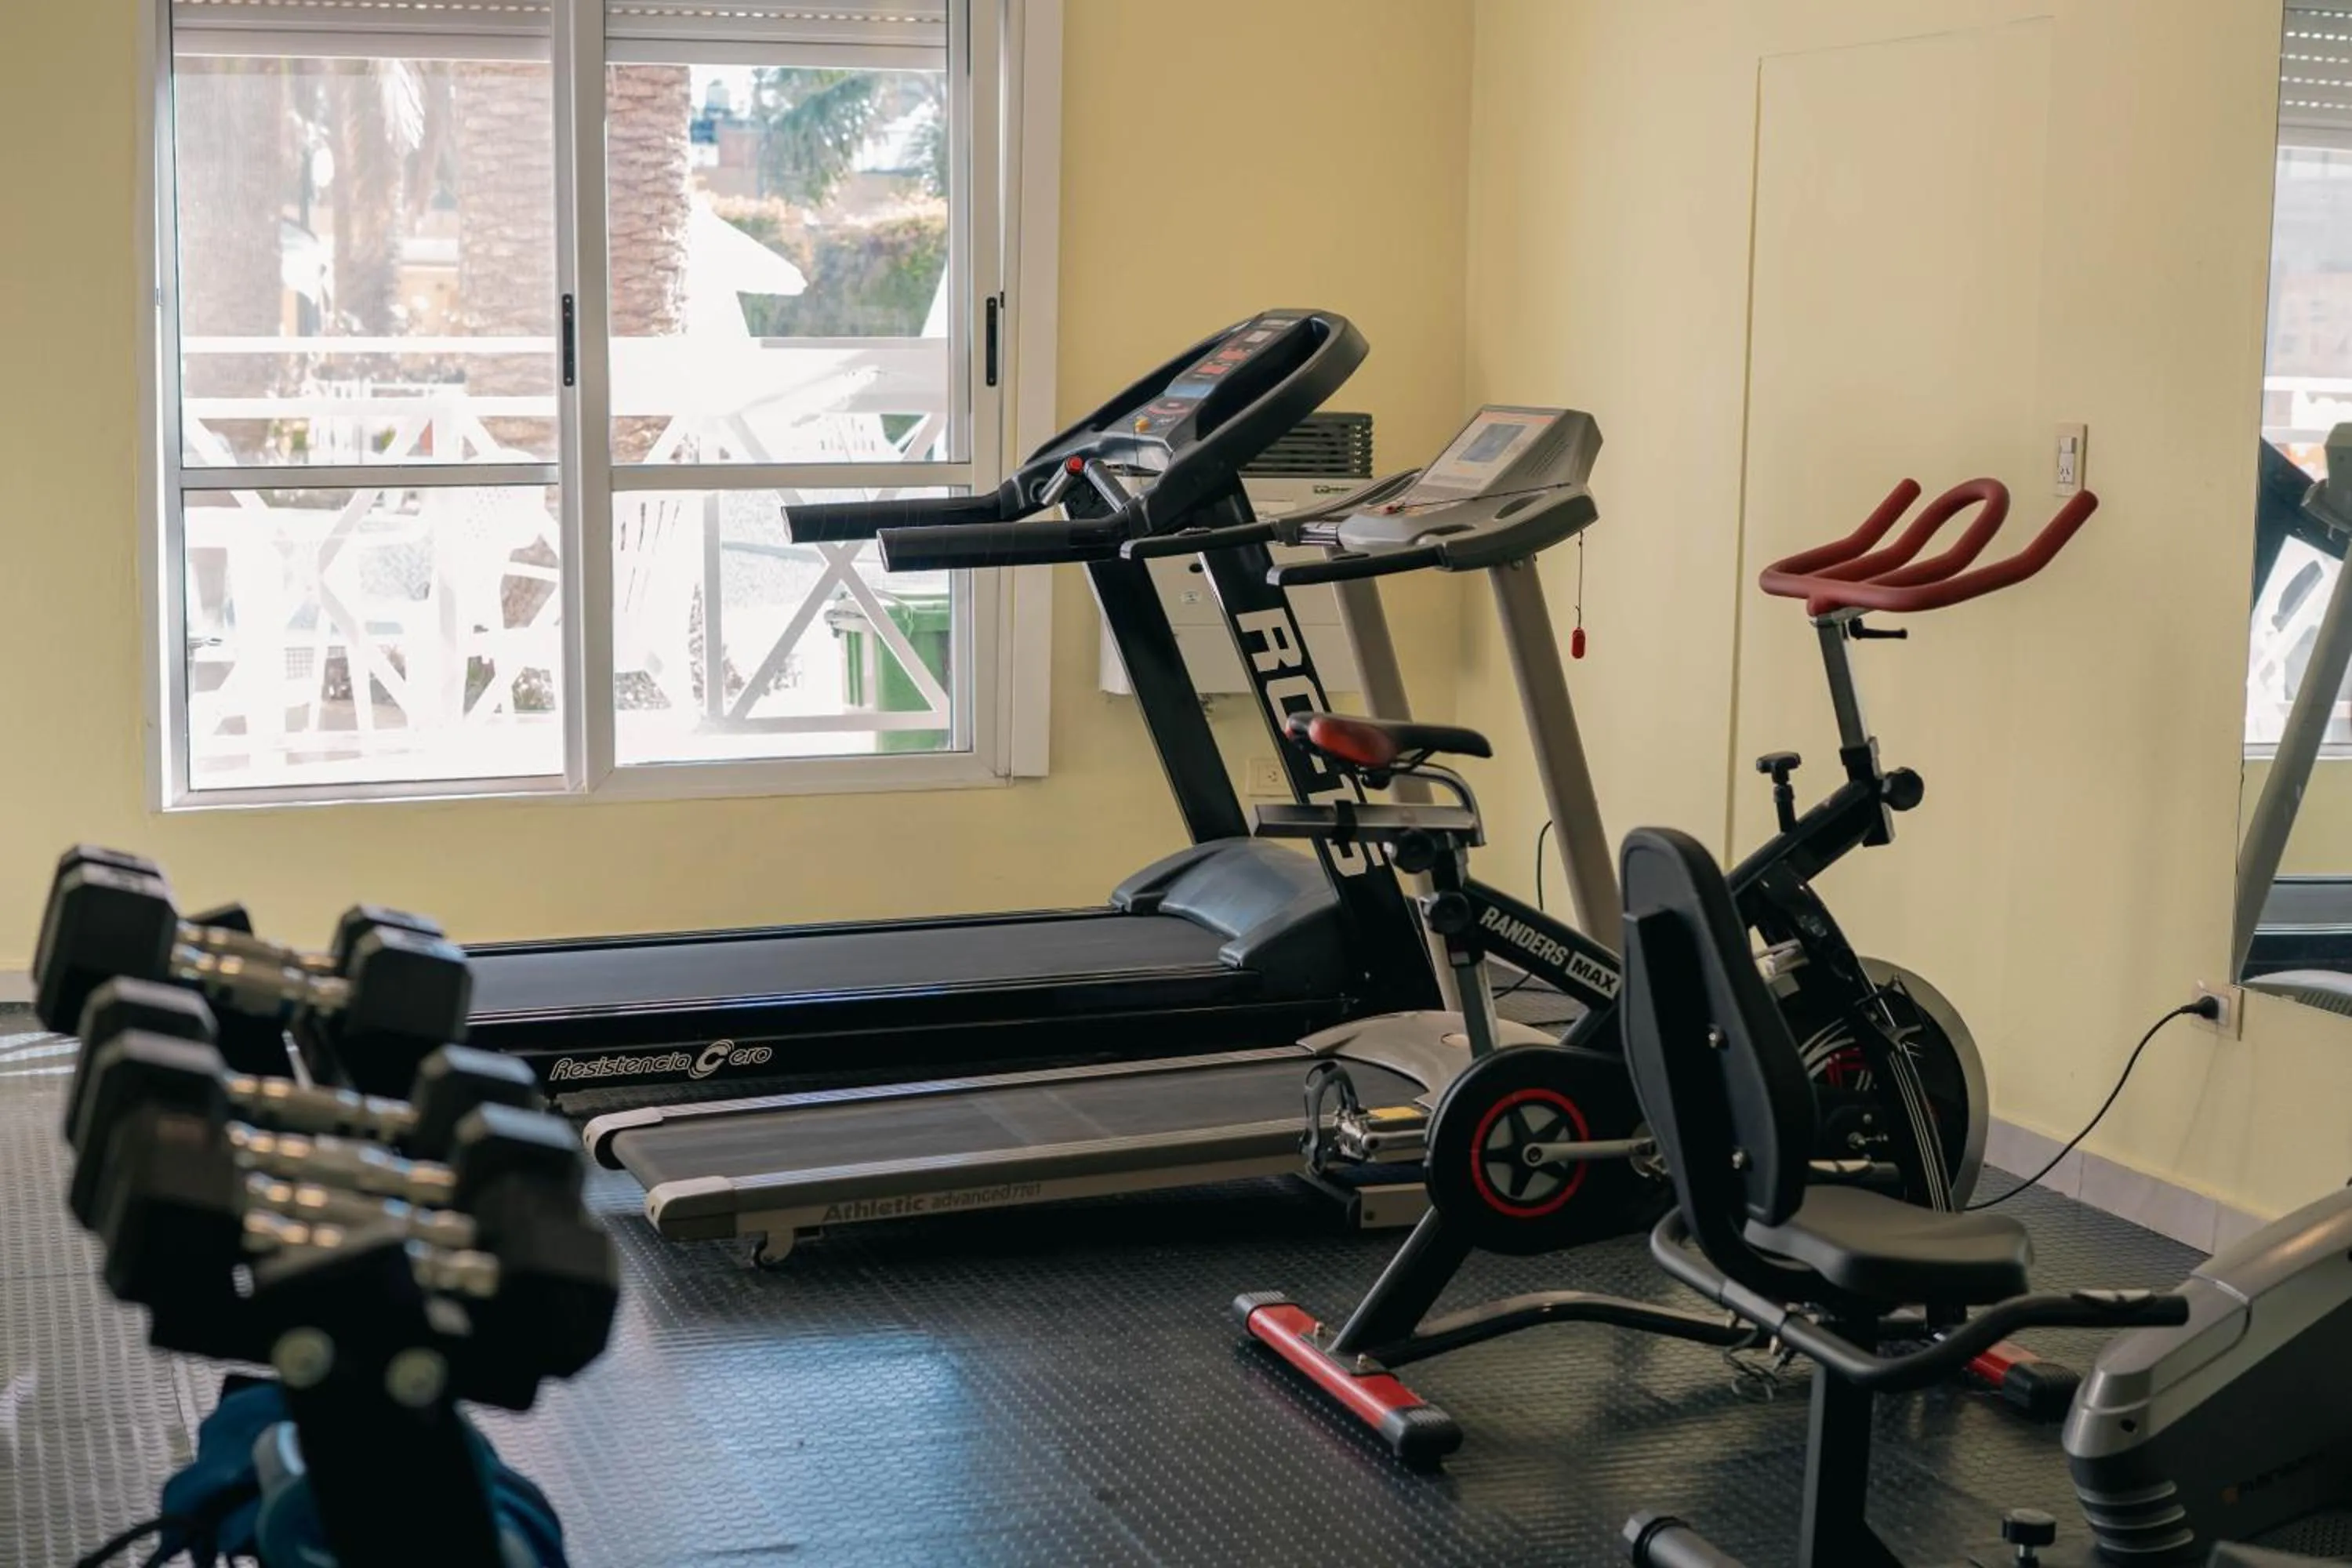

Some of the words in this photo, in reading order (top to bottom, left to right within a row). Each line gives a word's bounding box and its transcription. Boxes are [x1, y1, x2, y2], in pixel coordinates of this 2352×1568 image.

[1479, 906, 1569, 967] RANDERS
[1570, 956, 1617, 993] MAX
[549, 1052, 691, 1080] Resistencia
[688, 1039, 773, 1079] Cero
[822, 1195, 924, 1223] Athletic
[931, 1183, 1011, 1210] advanced
